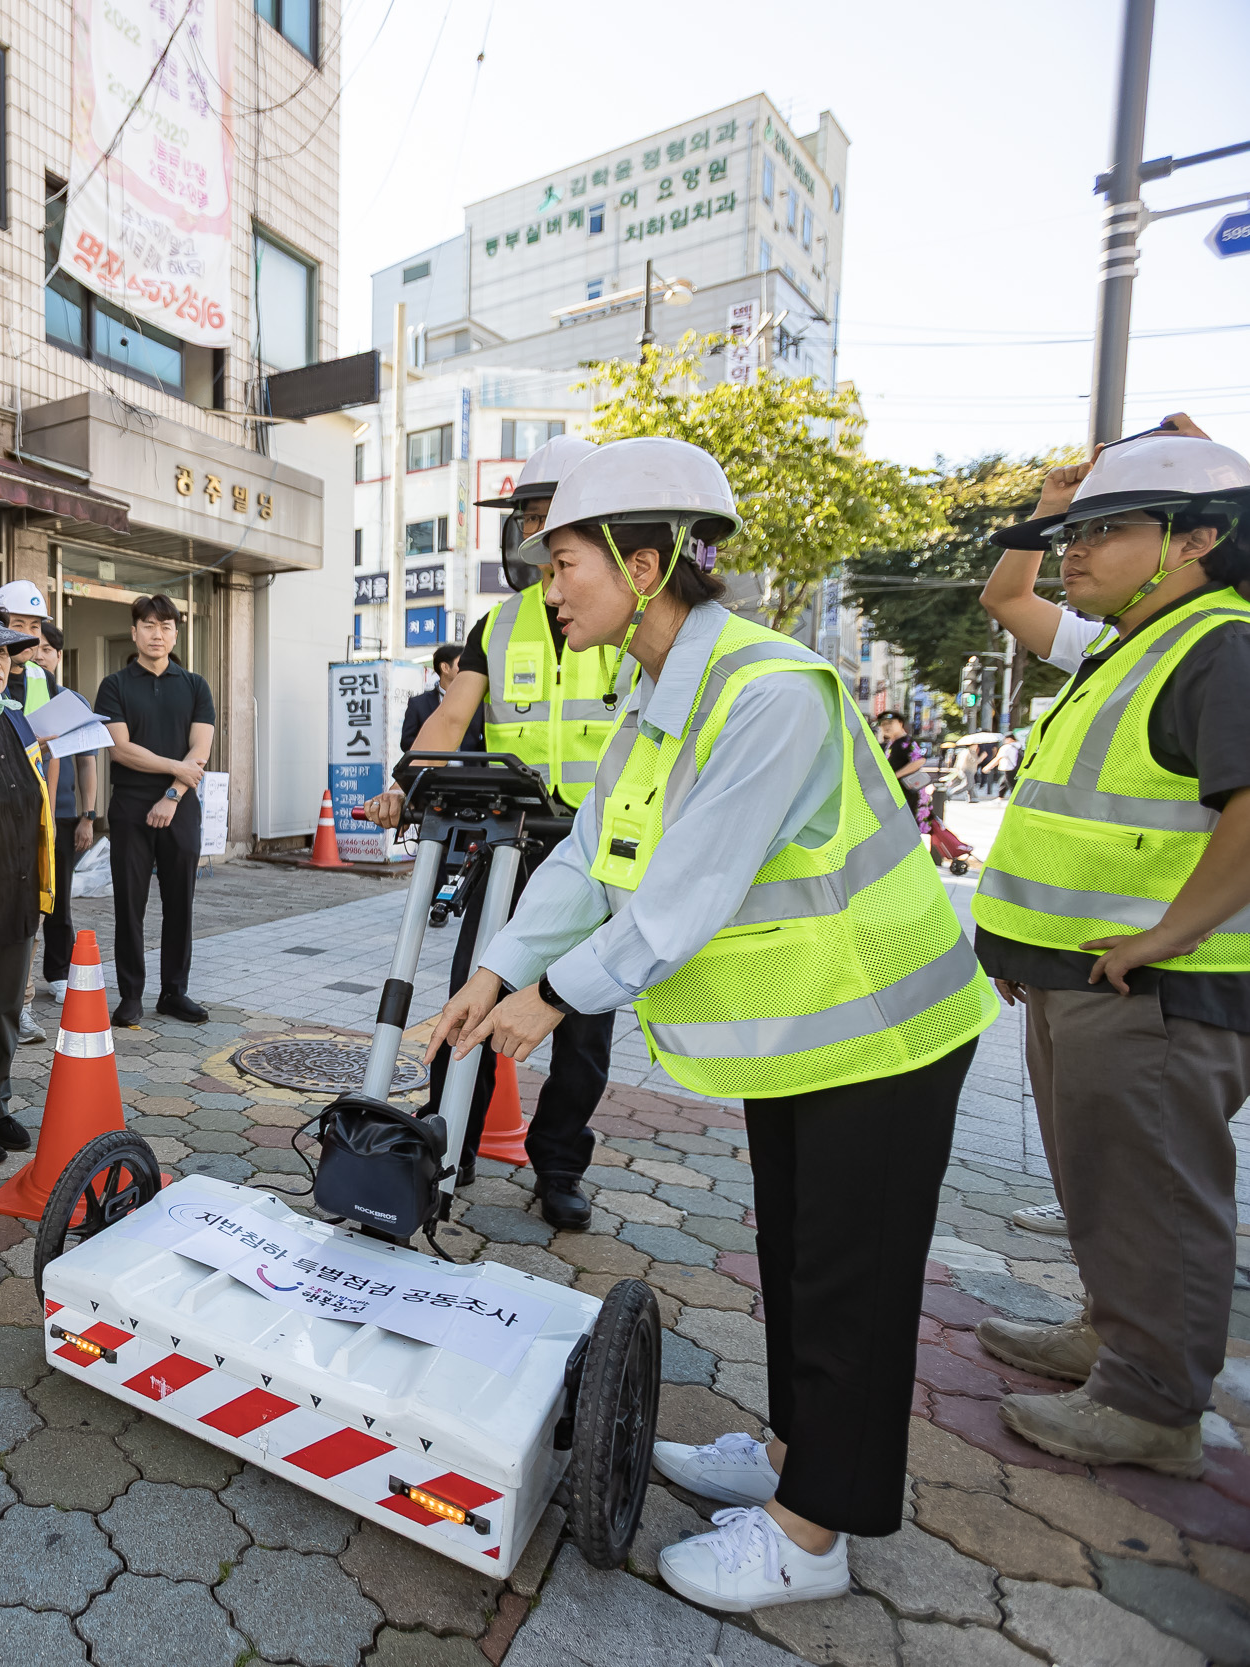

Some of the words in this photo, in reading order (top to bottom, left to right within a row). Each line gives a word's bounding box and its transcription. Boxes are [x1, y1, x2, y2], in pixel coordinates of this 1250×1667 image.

[655, 156, 729, 203] 요양원
[174, 464, 274, 520] 공주빌딩
[338, 673, 380, 696] 유진
[340, 766, 358, 777] 개인
[340, 808, 351, 819] 허
[354, 1204, 398, 1221] ROCKBROS
[195, 1211, 288, 1260] 지반침하
[291, 1257, 396, 1298] 특별점검
[401, 1287, 519, 1328] 공동조사
[302, 1290, 366, 1314] 행복광진
